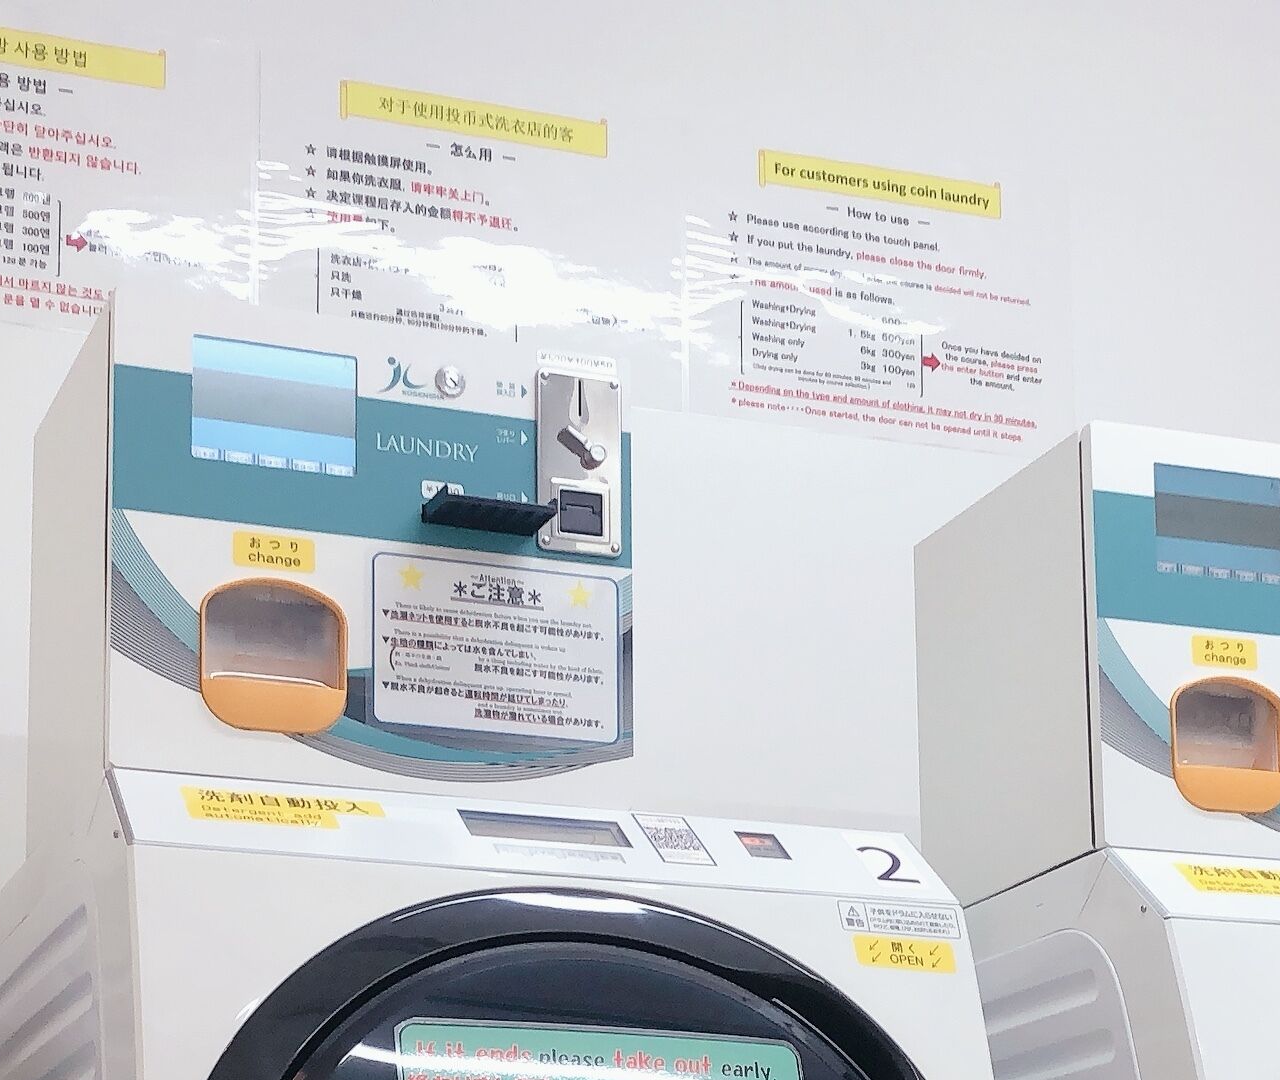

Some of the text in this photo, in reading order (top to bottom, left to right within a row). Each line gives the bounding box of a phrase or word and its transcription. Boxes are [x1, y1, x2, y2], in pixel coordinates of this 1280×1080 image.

[14, 40, 48, 61] 사용
[54, 47, 87, 68] 방법
[18, 75, 46, 95] 방법
[450, 141, 492, 162] 怎么用
[774, 162, 990, 210] For customers using coin laundry
[847, 206, 910, 226] How to use
[746, 213, 779, 228] Please
[782, 220, 800, 231] use
[802, 223, 849, 240] according
[851, 228, 862, 240] to
[865, 231, 880, 244] the
[883, 235, 910, 248] touch
[746, 234, 987, 279] If you put the laundry, please close the door firmly.
[835, 287, 843, 297] is
[752, 332, 805, 348] Washing only
[752, 347, 798, 363] Drying only
[376, 432, 478, 463] LAUNDRY
[250, 537, 298, 552] おつり
[248, 552, 301, 567] change
[1204, 640, 1244, 653] おつり
[1204, 651, 1247, 666] change
[199, 788, 369, 815] 洗剤自動投入
[856, 846, 921, 883] 2
[891, 941, 915, 954] 開く
[890, 953, 924, 967] OPEN
[539, 1049, 605, 1068] please
[613, 1048, 665, 1072] take
[673, 1052, 712, 1075] out
